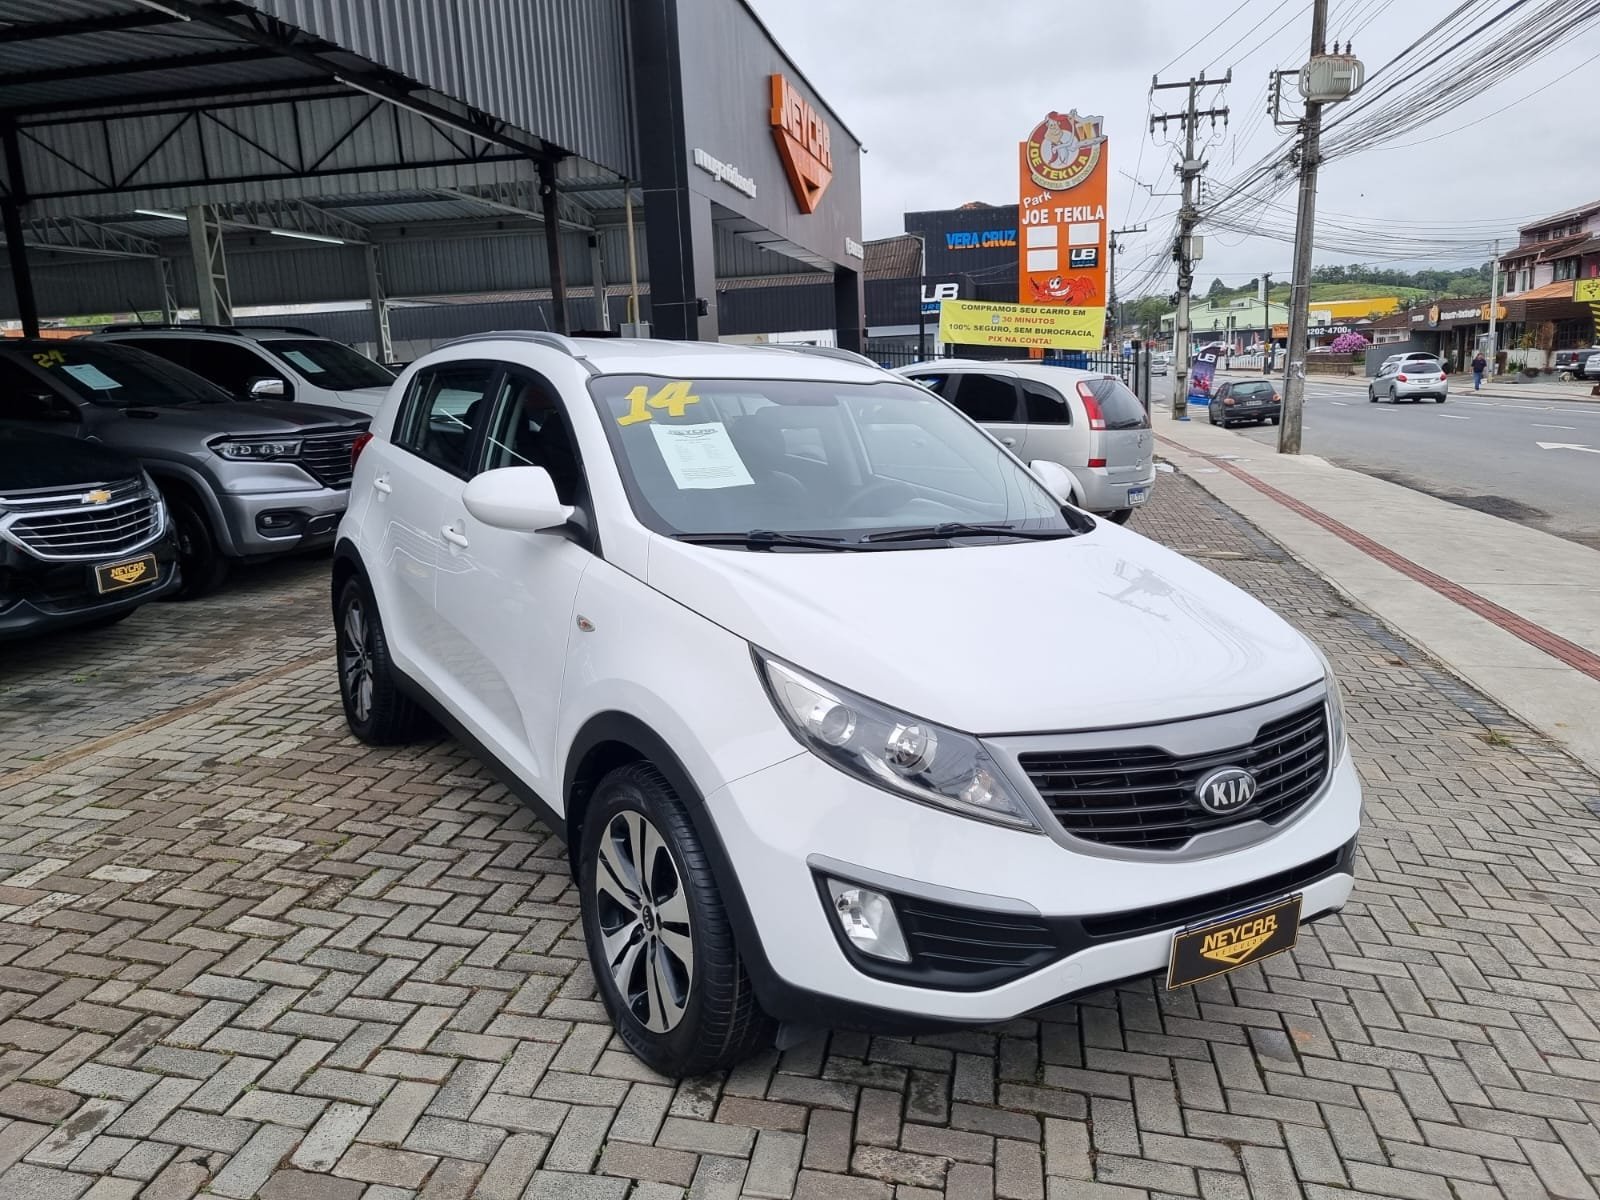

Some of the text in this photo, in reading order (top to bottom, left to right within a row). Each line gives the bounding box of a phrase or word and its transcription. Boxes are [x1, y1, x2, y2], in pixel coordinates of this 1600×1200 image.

[771, 74, 832, 173] NEYCAR
[1030, 141, 1041, 167] JOE
[1042, 155, 1089, 180] TEKILA
[1023, 191, 1052, 208] Park
[1022, 205, 1105, 225] JOE TEKILA
[946, 230, 1016, 249] VERA CRUZ
[1072, 248, 1096, 260] UB
[921, 283, 959, 303] UB
[961, 304, 1017, 313] COMPRAMOS
[1040, 308, 1070, 316] CARRO
[949, 323, 971, 331] 100%
[974, 325, 1012, 333] SEGURO,
[1035, 328, 1095, 338] BUROCRACIA,
[1015, 317, 1055, 325] MINUTOS
[1020, 337, 1052, 345] CONTA!
[617, 381, 700, 426] 14
[110, 562, 147, 578] NEYCAR
[1211, 774, 1251, 807] KIA
[1199, 914, 1278, 954] NEYCAR
